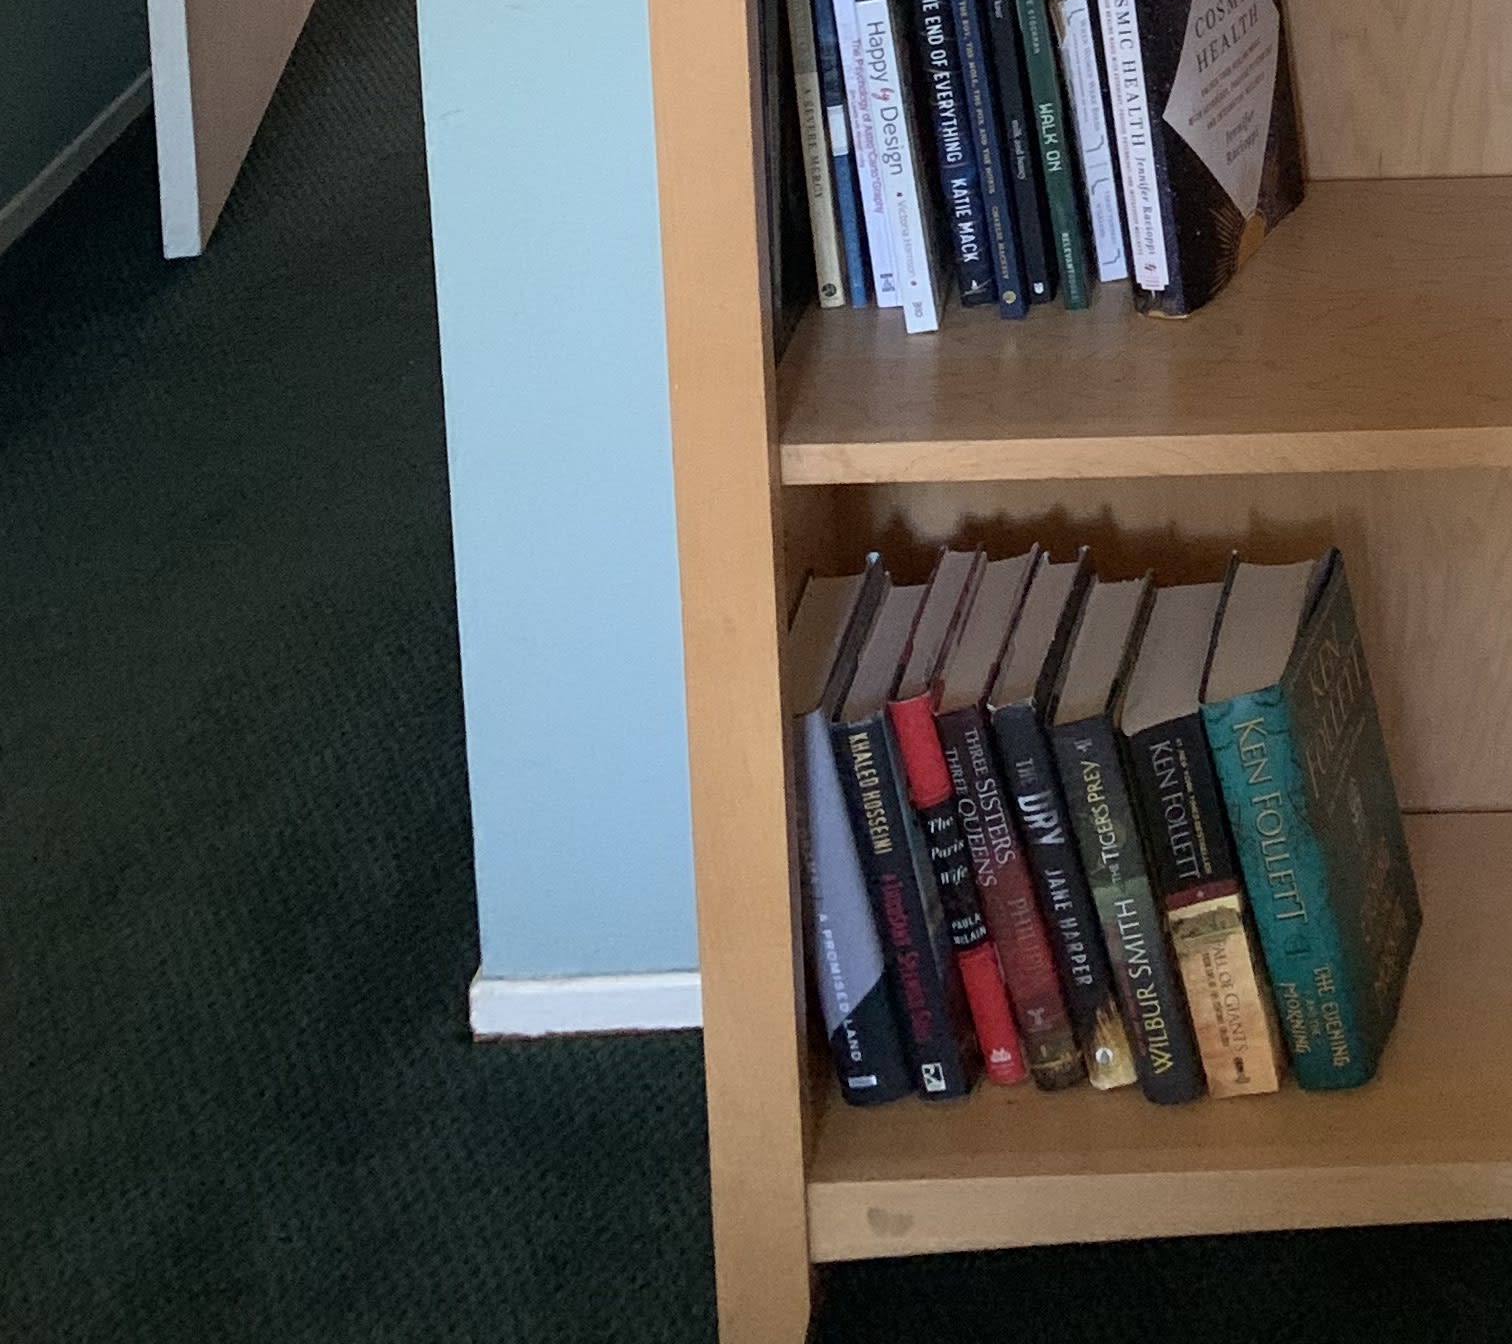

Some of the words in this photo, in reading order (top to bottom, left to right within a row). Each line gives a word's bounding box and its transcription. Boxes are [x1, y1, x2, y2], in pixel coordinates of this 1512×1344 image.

[866, 21, 892, 82] Happy
[926, 17, 944, 45] END
[931, 50, 948, 68] OF
[934, 73, 964, 162] EVERYTHING
[1122, 60, 1145, 147] HEALTH
[878, 107, 904, 175] Design
[951, 178, 972, 219] KATIE
[958, 222, 978, 262] MACK
[848, 731, 878, 788] KHALED
[965, 728, 985, 776] THREE
[1233, 717, 1268, 783] KEN
[861, 792, 893, 855] HOSSEINI
[946, 748, 968, 794] THREE
[958, 798, 997, 887] QUEENS
[974, 778, 1016, 865] SISTERS
[1250, 791, 1308, 923] FOLLETT
[1044, 870, 1070, 911] JANE
[1060, 918, 1092, 985] HARPER
